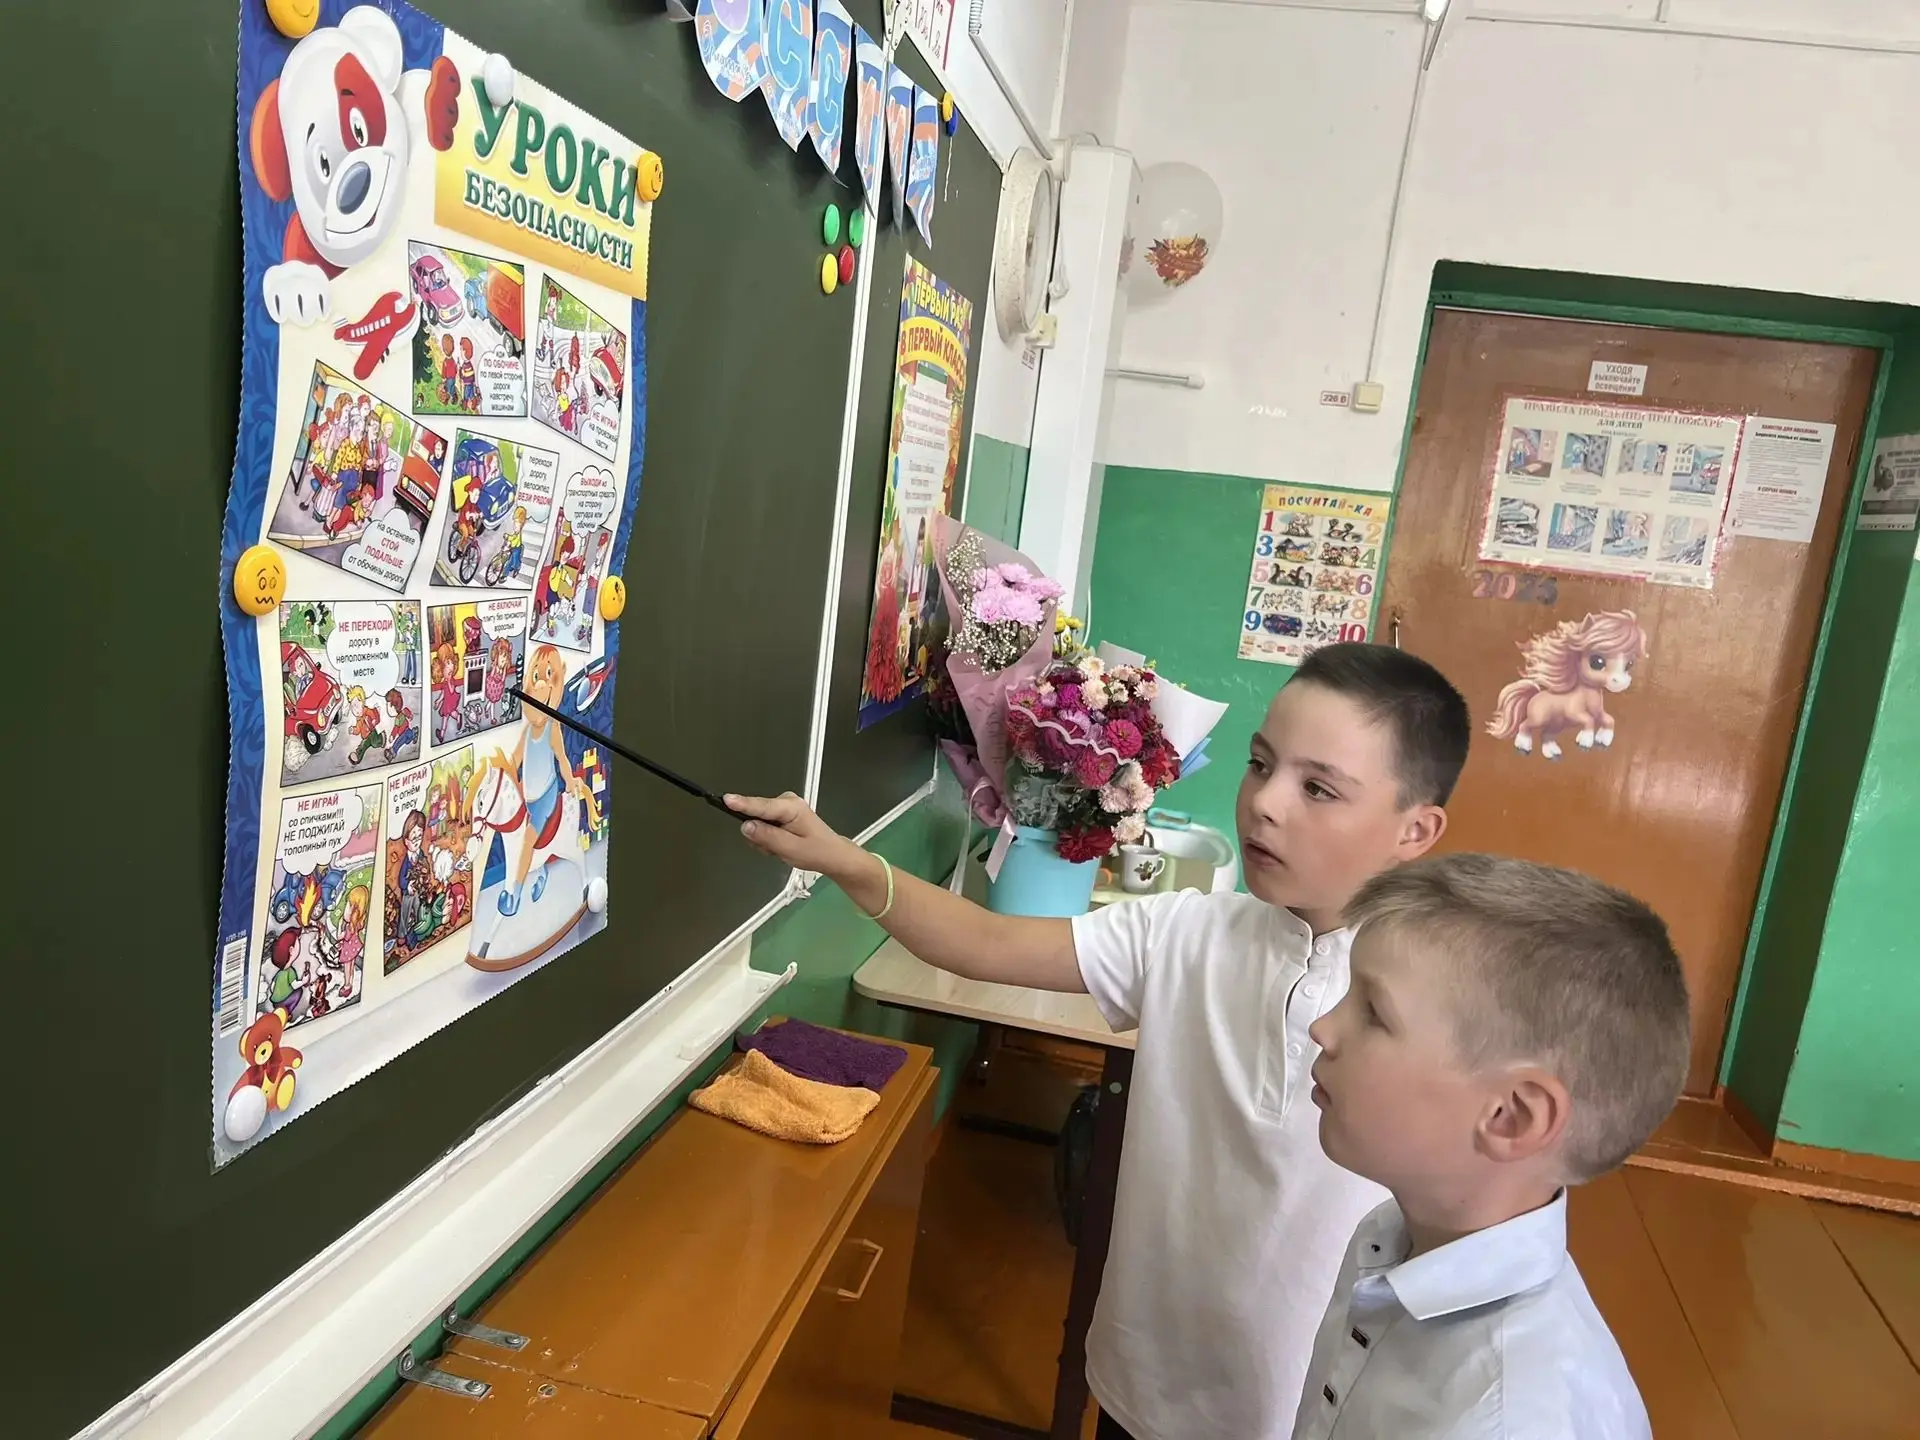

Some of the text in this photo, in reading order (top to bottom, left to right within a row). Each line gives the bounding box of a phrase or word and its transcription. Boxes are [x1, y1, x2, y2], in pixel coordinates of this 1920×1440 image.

[471, 76, 637, 226] УРОКИ
[465, 169, 633, 269] БЕЗОПАСНОСТИ
[914, 275, 950, 321] ПЕРВЫЙ
[900, 330, 907, 356] В
[908, 327, 944, 357] ПЕРВЫЙ
[484, 359, 520, 370] ПО ОБОЧИНЕ
[1606, 364, 1633, 375] УХОДЯ
[1523, 402, 1575, 416] ПРАВИЛА
[1578, 406, 1646, 422] ПОВЕДЕНИЯ
[1675, 414, 1724, 429] ПОЖАРЕ
[1597, 418, 1643, 430] ДЛЯ ДЕТЕЙ
[518, 491, 533, 502] ВЕЗИ
[1278, 496, 1373, 517] ПОСЧИТАЙ-КА
[1262, 511, 1275, 532] 1
[377, 523, 416, 546] на остановке
[380, 537, 400, 552] СТОЙ
[1366, 523, 1382, 545] 2
[1256, 535, 1274, 557] 3
[364, 545, 404, 569] ПОДАЛЬШЕ
[1359, 548, 1377, 570] 4
[348, 555, 405, 584] от обочины дороги
[1252, 561, 1269, 583] 5
[1355, 574, 1373, 595] 6
[1250, 586, 1265, 607] 7
[1351, 599, 1367, 620] 8
[339, 619, 393, 632] НЕ ПЕРЕХОДИ
[1245, 610, 1262, 631] 9
[1338, 622, 1366, 643] 10
[349, 638, 373, 649] дорогу
[336, 652, 389, 664] неположенном
[353, 668, 375, 677] месте
[389, 766, 428, 792] НЕ ИГРАЙ
[297, 793, 339, 812] НЕ ИГРАЙ
[393, 784, 421, 803] с огнём
[395, 798, 419, 814] в лесу
[284, 819, 345, 843] НЕ ПОДЖИГАЙ
[288, 818, 298, 828] со
[284, 837, 342, 857] тополиный пух
